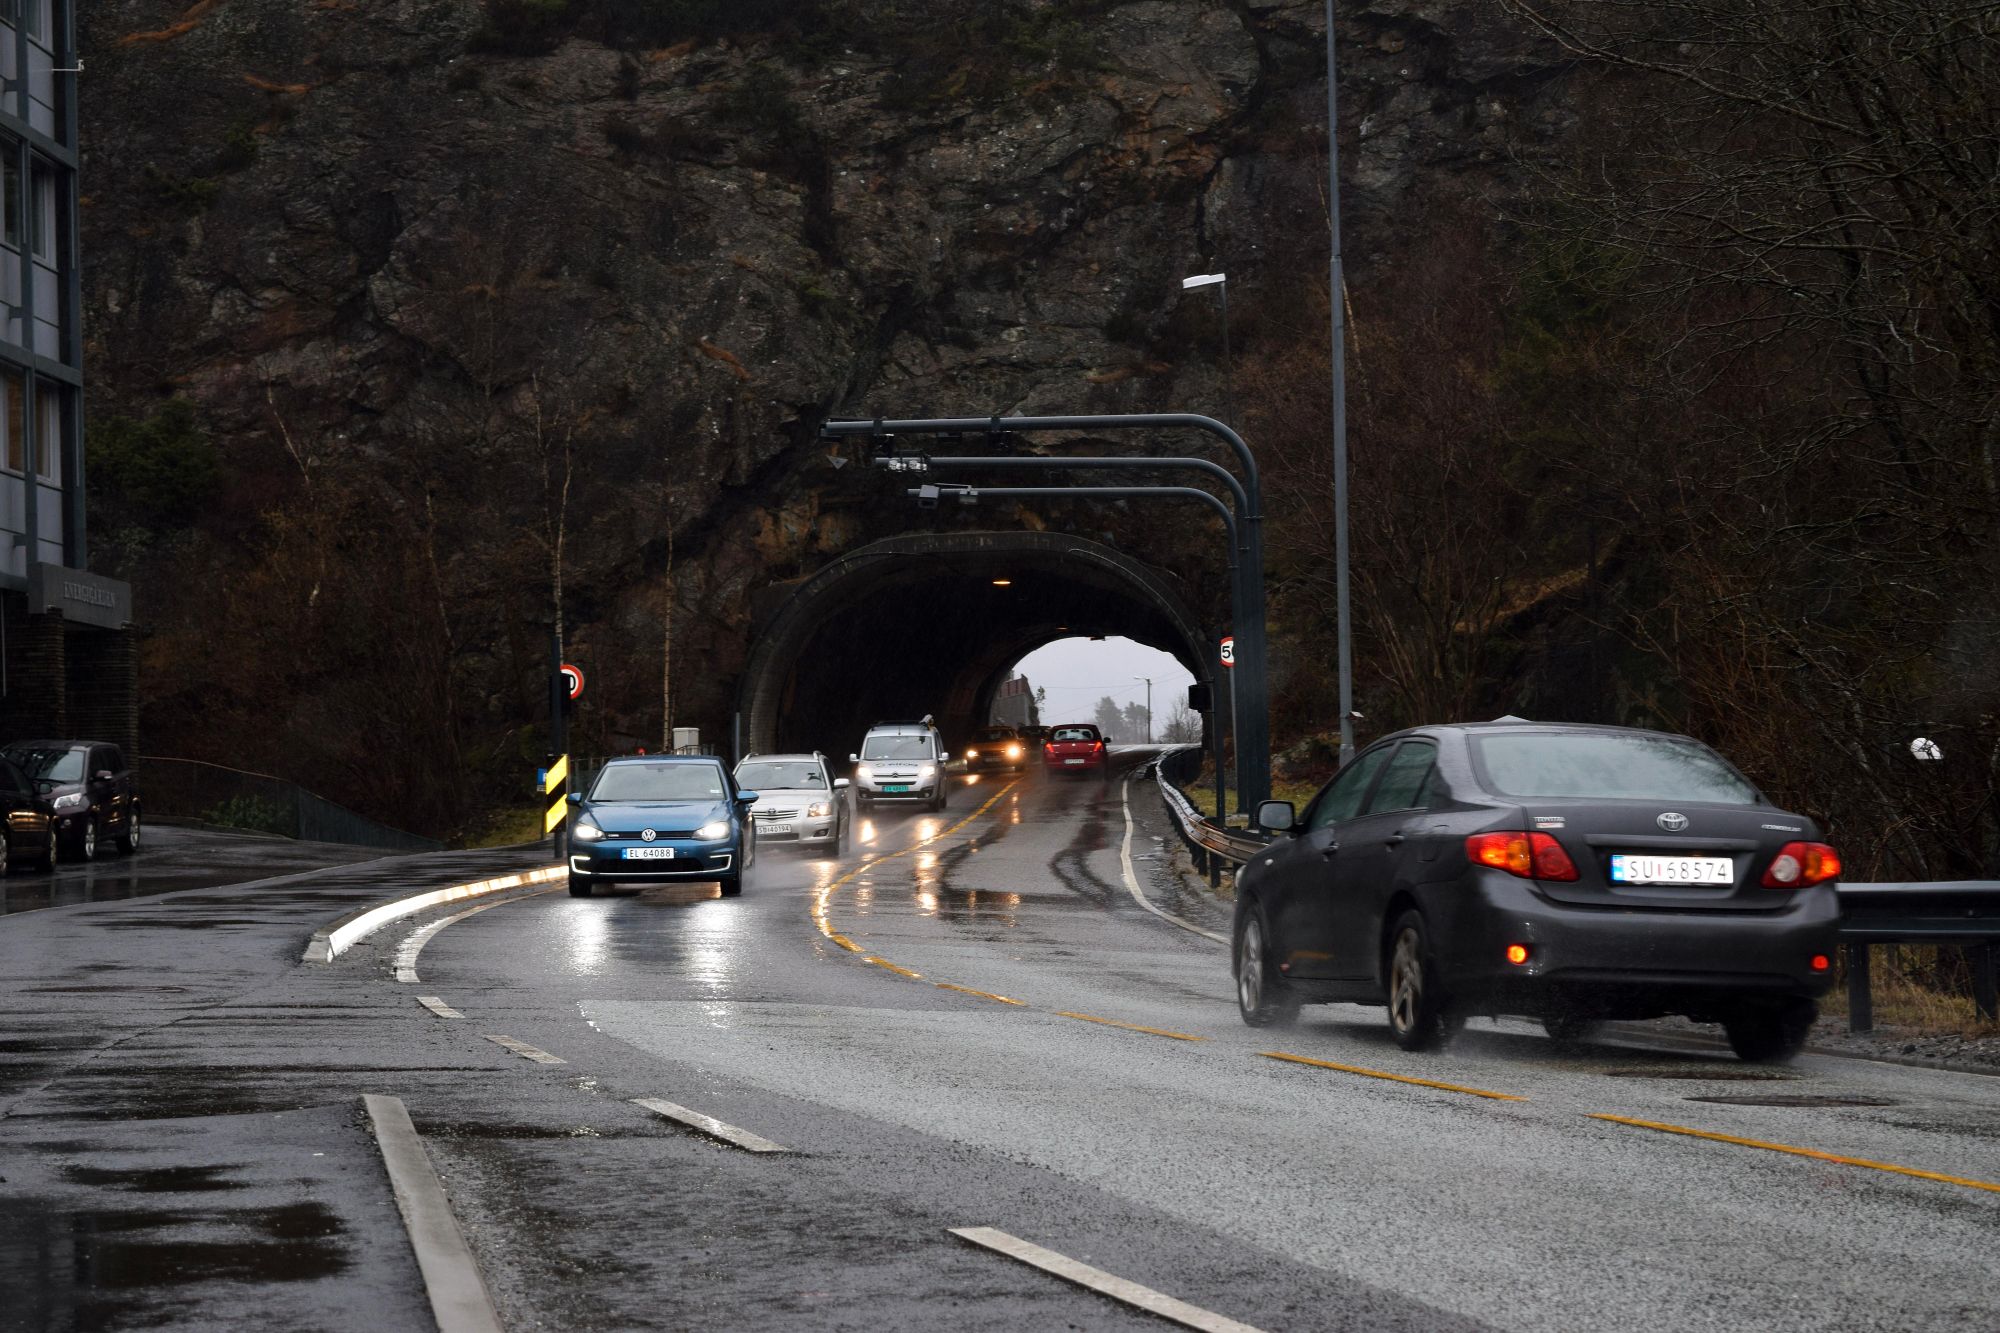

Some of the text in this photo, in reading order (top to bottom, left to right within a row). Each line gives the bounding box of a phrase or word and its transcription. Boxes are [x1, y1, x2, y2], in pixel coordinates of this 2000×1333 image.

[1222, 646, 1234, 659] 5
[629, 848, 671, 858] EL 64088
[1630, 860, 1728, 881] SU 68574
